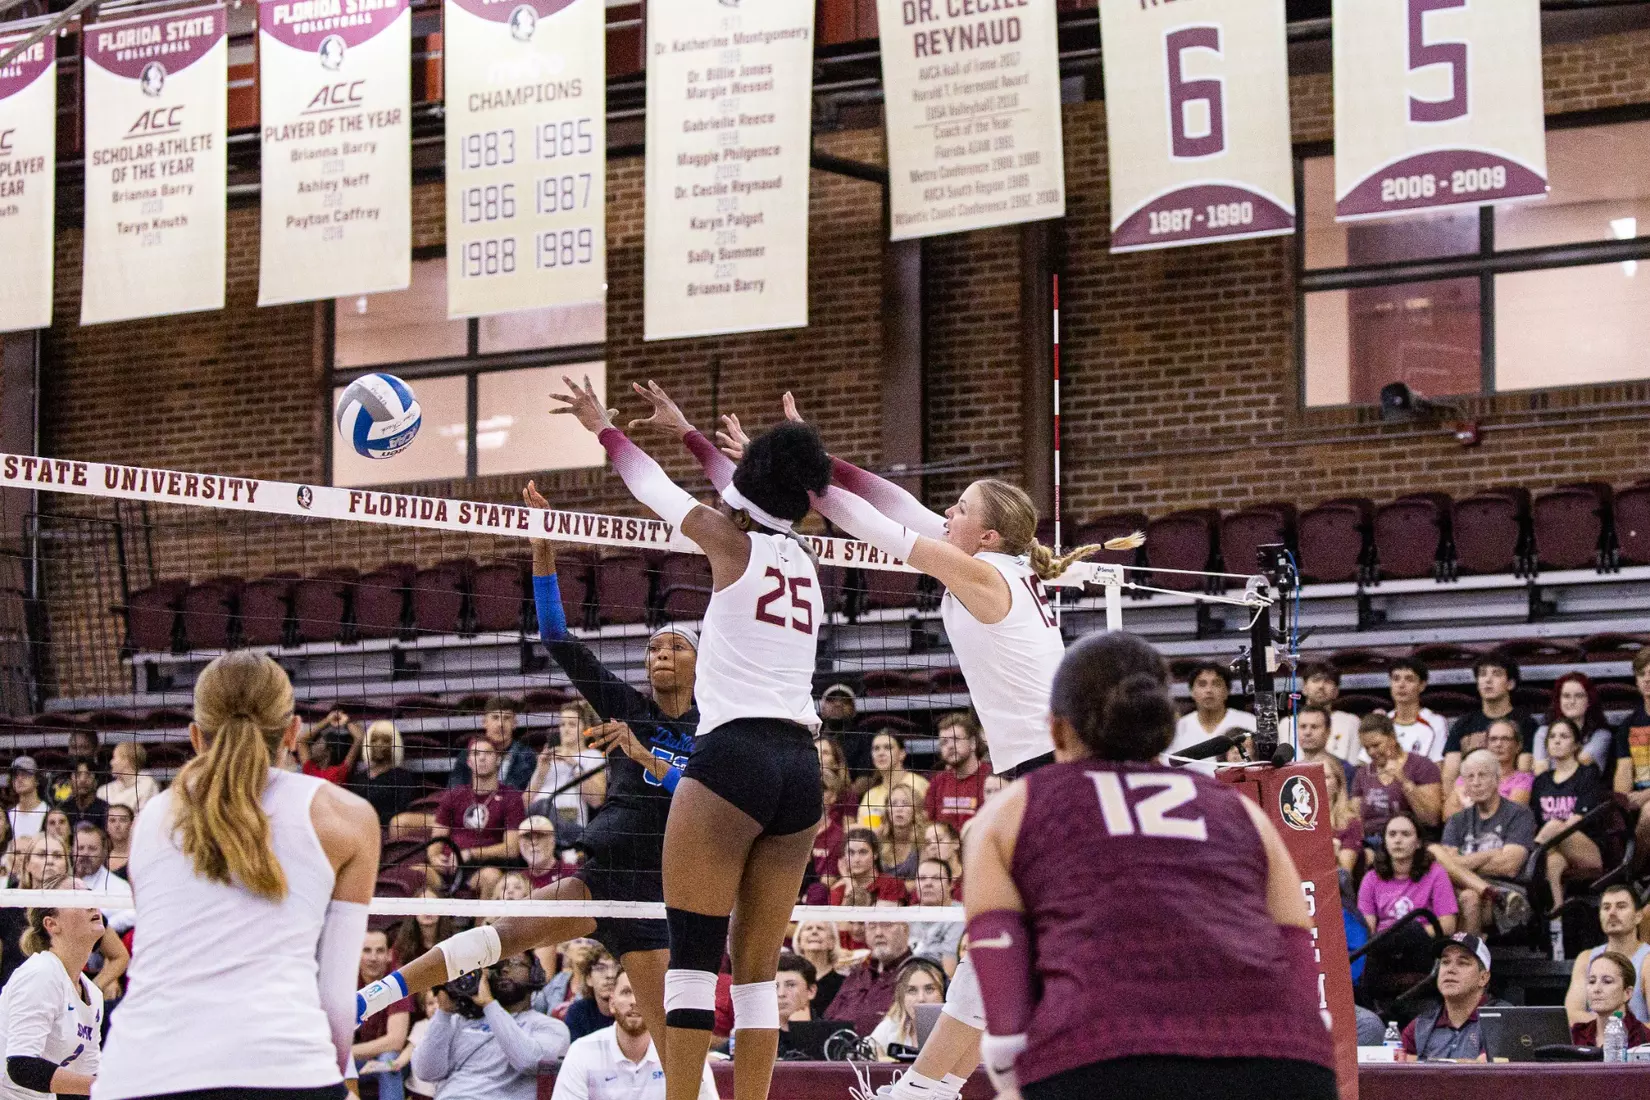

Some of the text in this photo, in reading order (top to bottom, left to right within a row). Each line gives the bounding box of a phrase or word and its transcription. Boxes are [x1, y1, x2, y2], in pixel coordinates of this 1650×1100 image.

[273, 0, 341, 25] FLORIDA
[903, 0, 1028, 25] DR. CEC
[98, 16, 214, 52] FLORIDA STATE
[914, 16, 1022, 58] REYNAUD
[1405, 0, 1470, 125] 5
[307, 80, 366, 108] ACC
[468, 78, 583, 113] CHAMPIONS
[1165, 25, 1225, 160] 6
[128, 105, 185, 133] ACC
[264, 109, 401, 143] PLAYER OF THE YEAR
[92, 134, 212, 166] SCHOLAR-ATHLETE
[461, 119, 592, 170] 1983 1985
[0, 157, 44, 178] PLAYER
[112, 158, 194, 184] OF THE YEAR
[1382, 174, 1436, 202] 2006
[1452, 165, 1506, 194] 2009
[0, 180, 24, 198] EAR
[161, 184, 193, 198] Barry
[461, 173, 592, 224] 1986 1987
[1149, 208, 1193, 235] 1987
[1206, 201, 1254, 230] 1990
[461, 228, 592, 278] 1988 1989
[4, 456, 259, 503] STATE UNIVERSITY
[348, 490, 674, 542] FLORIDA STATE UNIVERSITY
[756, 566, 813, 635] 25
[1083, 770, 1208, 841] 12
[60, 1043, 85, 1067] 2
[652, 1071, 665, 1080] SM
